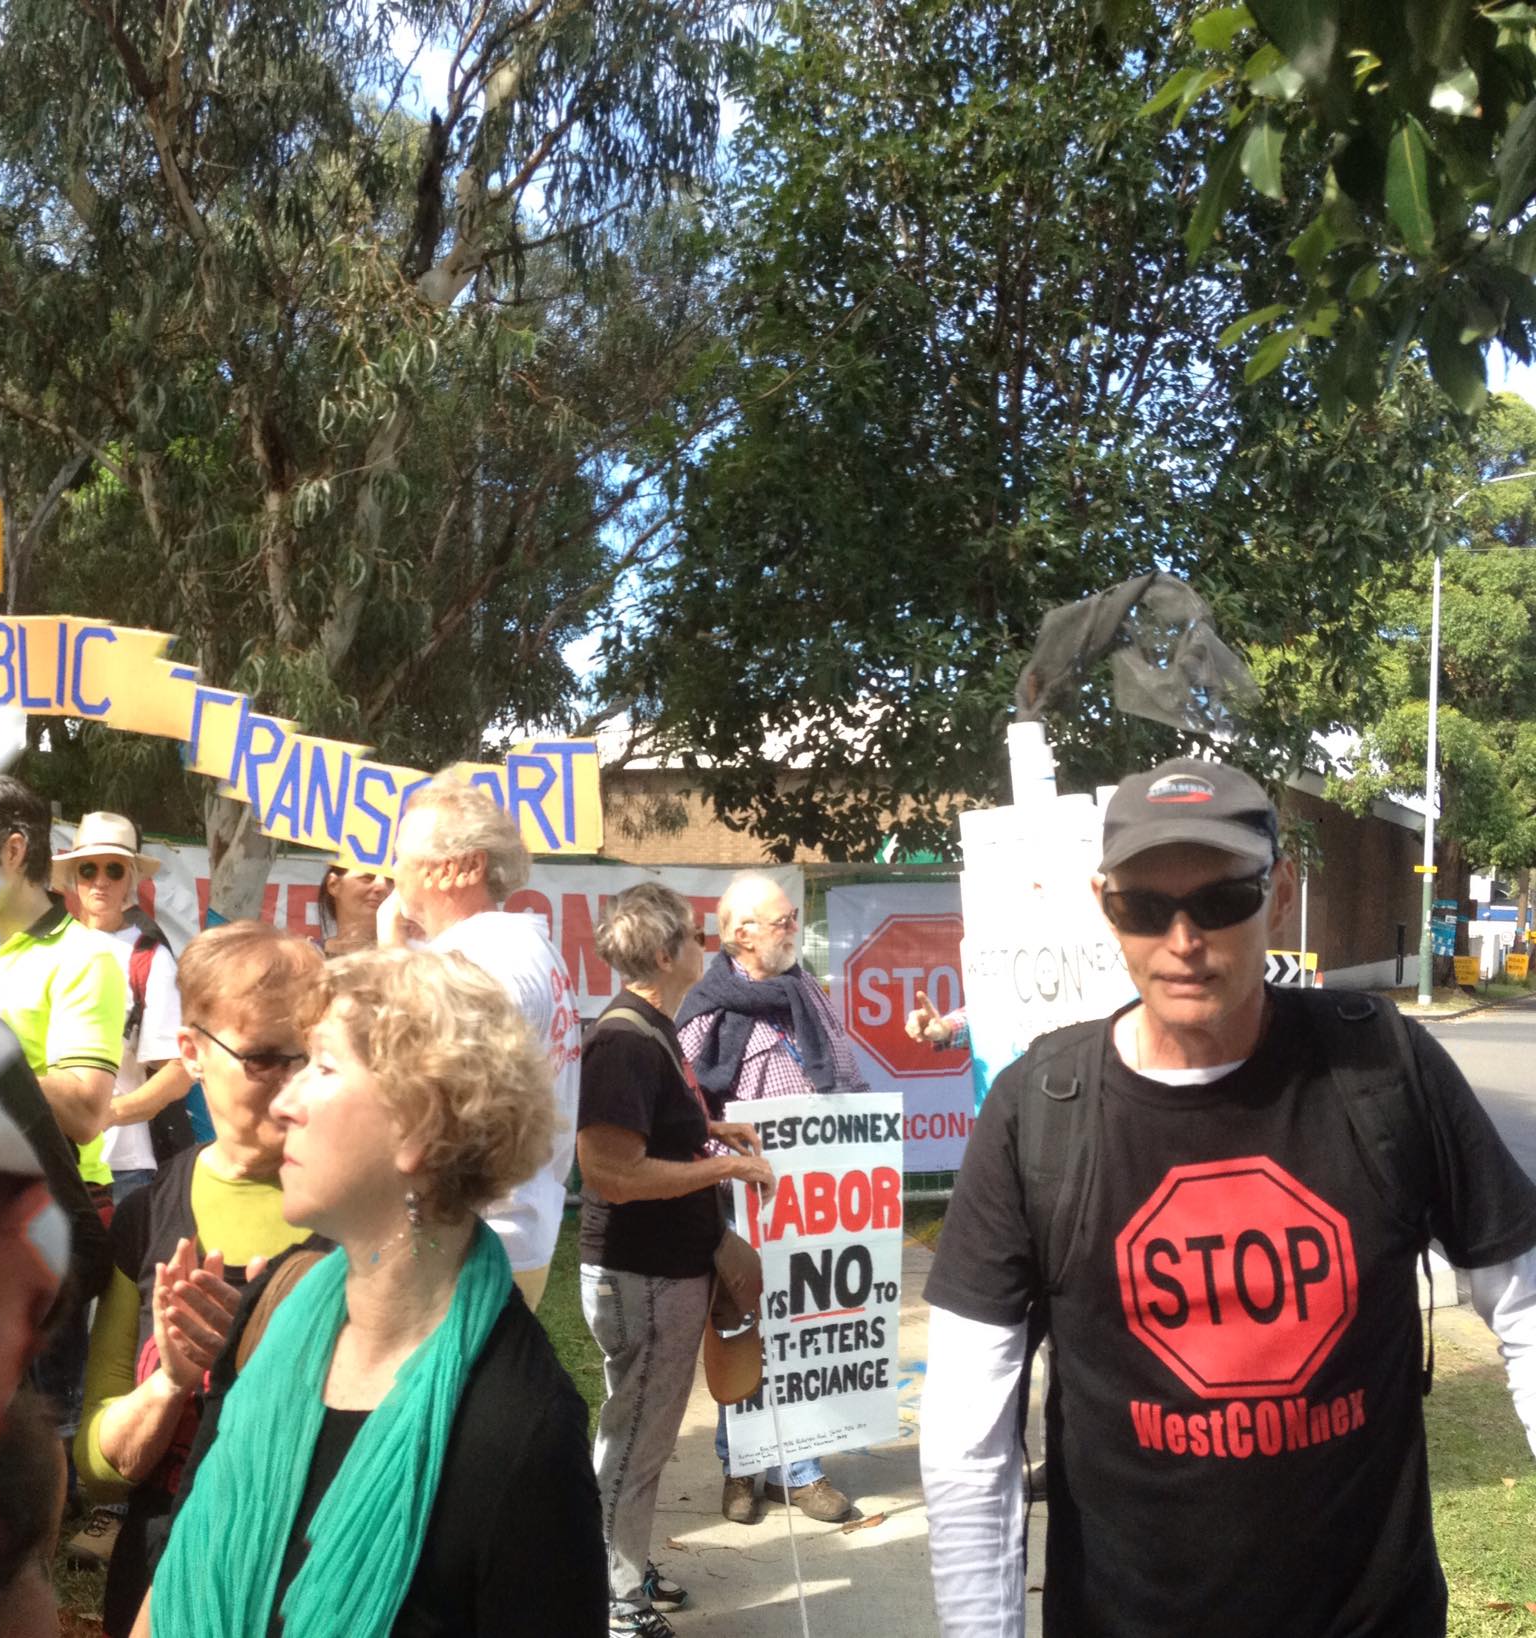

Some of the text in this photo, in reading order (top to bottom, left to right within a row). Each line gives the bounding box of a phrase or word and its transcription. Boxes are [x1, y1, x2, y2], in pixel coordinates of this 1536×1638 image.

[171, 667, 597, 866] TRANSRT
[857, 964, 963, 1028] STO
[788, 1244, 873, 1316] NO
[872, 1280, 899, 1304] TO
[1144, 1224, 1332, 1330] STOP
[1129, 1388, 1368, 1459] WestCONnex
